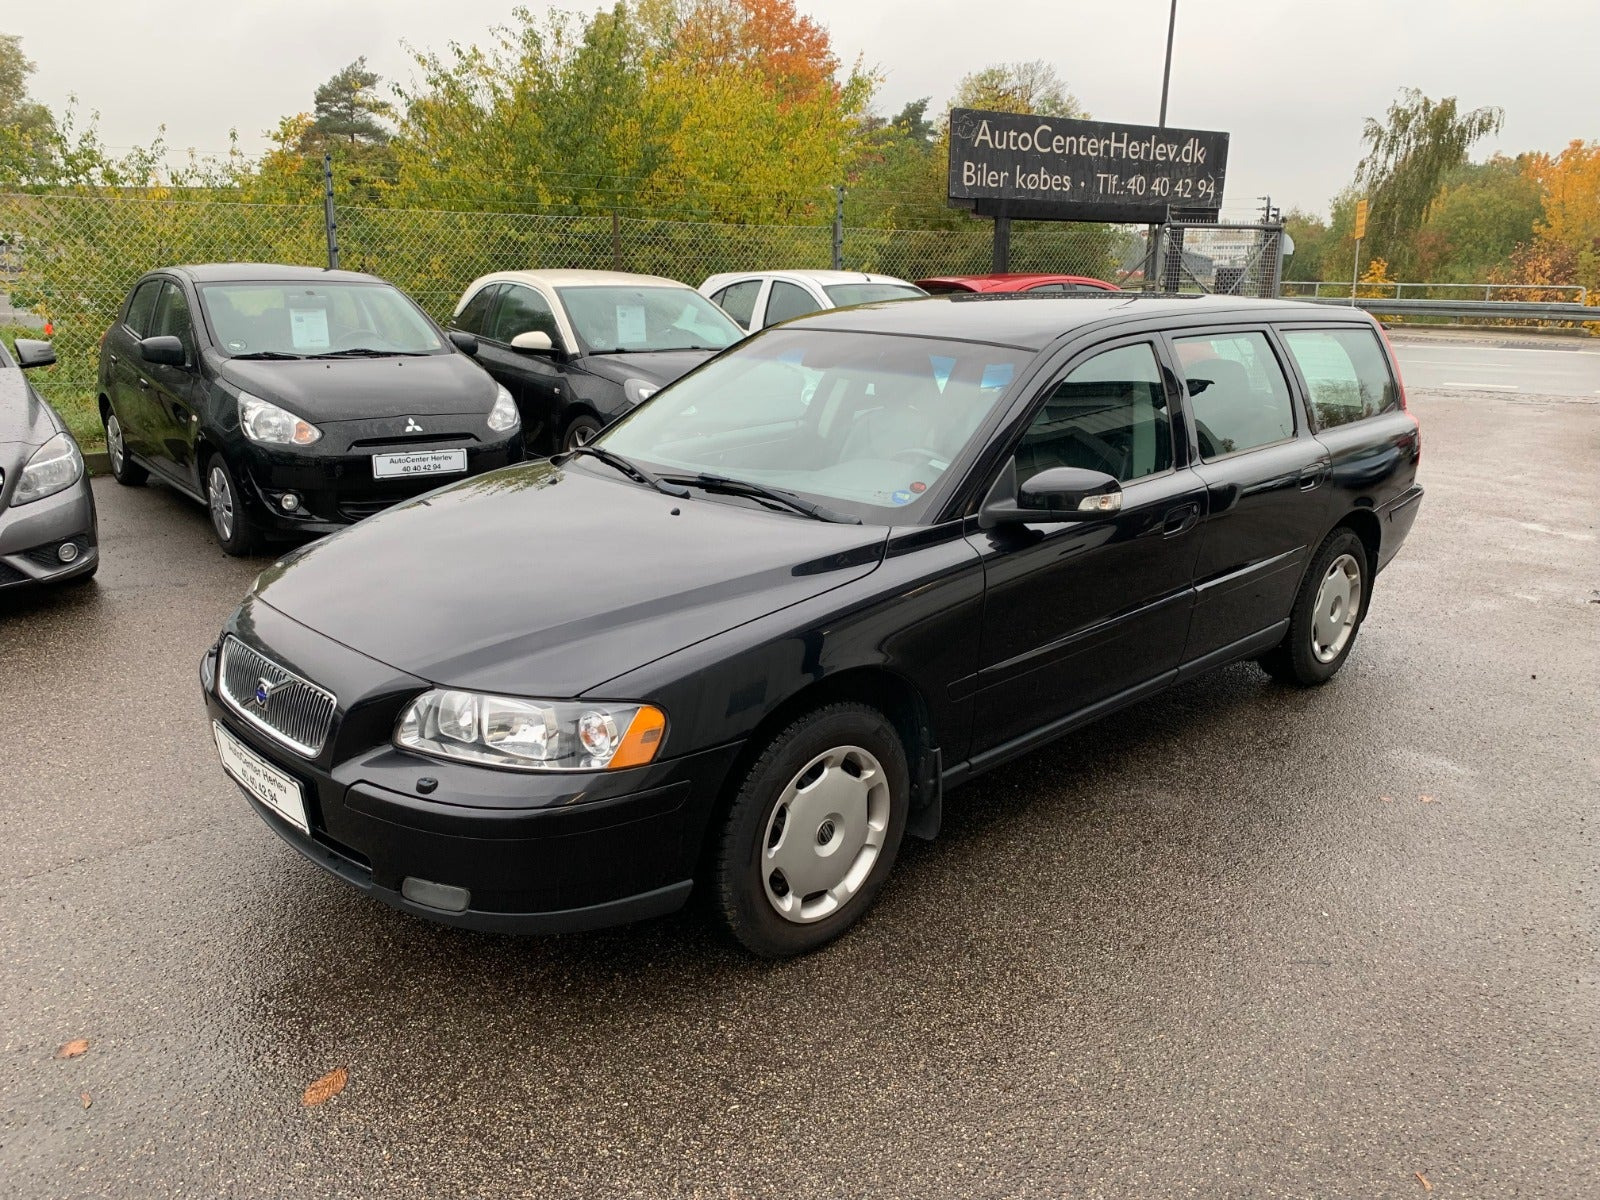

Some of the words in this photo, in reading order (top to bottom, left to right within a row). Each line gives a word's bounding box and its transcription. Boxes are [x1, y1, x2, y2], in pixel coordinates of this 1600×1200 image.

[974, 120, 1206, 164] AutoCenterHerlev.dk
[962, 160, 1009, 188] Biler
[1015, 164, 1072, 192] købes
[1151, 177, 1170, 197] 40
[1174, 178, 1192, 198] 42
[1198, 179, 1216, 199] 94
[390, 456, 429, 464] AutoCenter
[412, 464, 421, 472] 40
[422, 463, 431, 471] 42
[258, 783, 268, 798] 42
[267, 788, 278, 804] 94
[262, 768, 287, 795] Herlev
